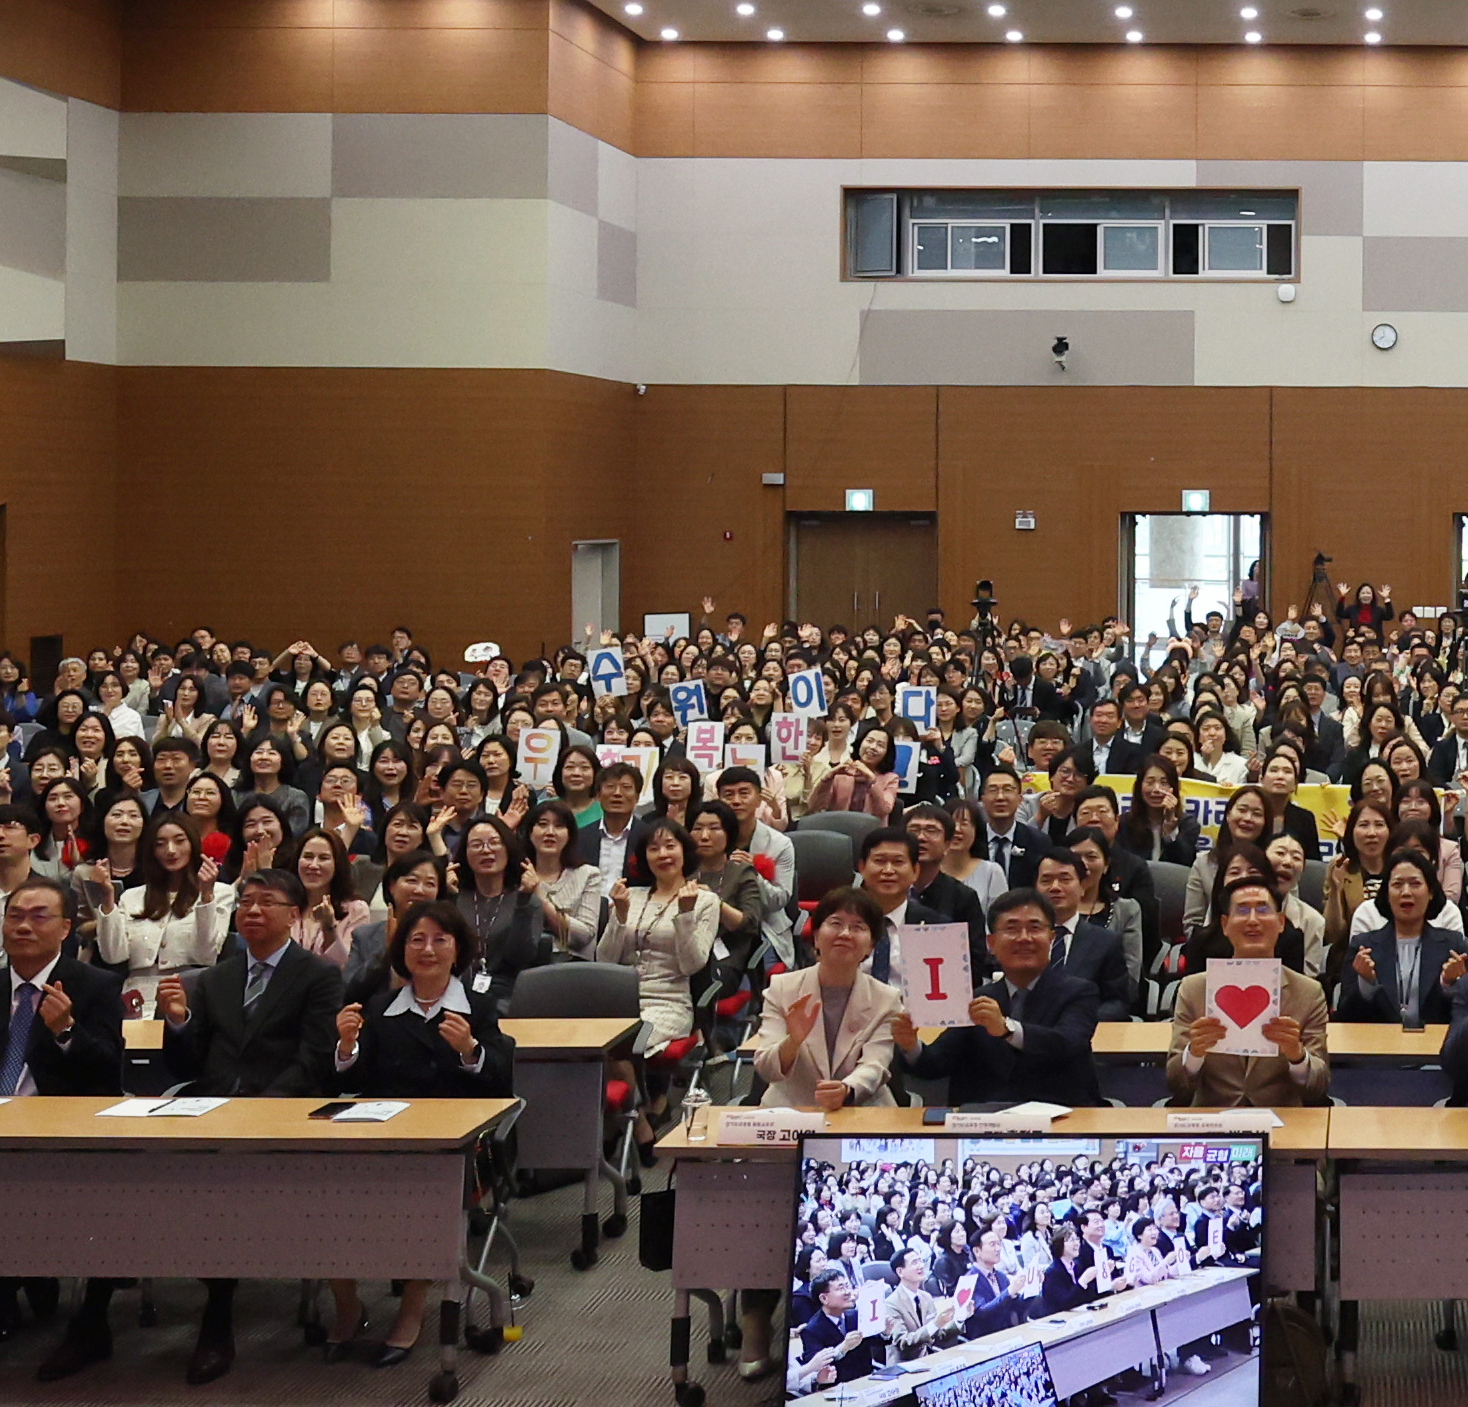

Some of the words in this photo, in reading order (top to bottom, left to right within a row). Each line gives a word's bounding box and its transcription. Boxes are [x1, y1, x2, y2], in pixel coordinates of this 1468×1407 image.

[592, 651, 624, 693] 수
[792, 672, 825, 712] 이
[902, 690, 935, 730] 다
[524, 732, 554, 780] 우
[690, 725, 720, 769] 복
[775, 716, 804, 761] 한
[923, 957, 948, 1001] I
[756, 1129, 776, 1141] 국장
[1181, 1145, 1205, 1159] 자율
[1205, 1148, 1229, 1162] 균형
